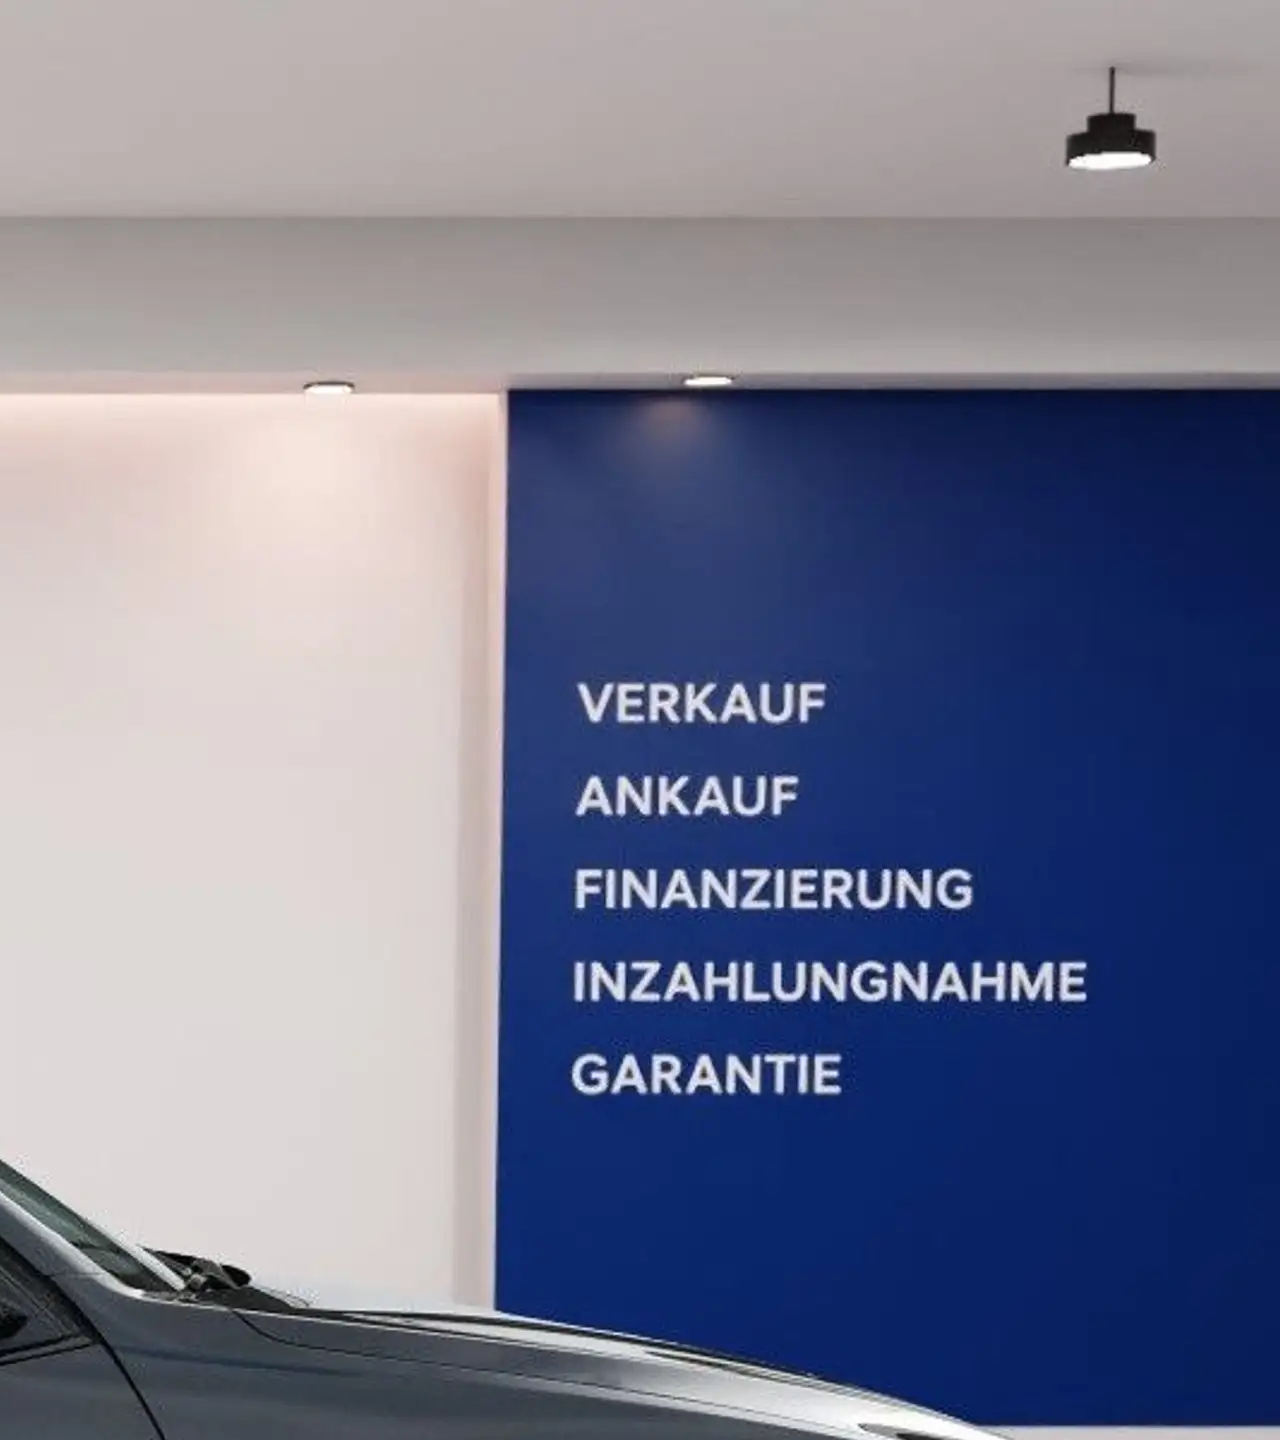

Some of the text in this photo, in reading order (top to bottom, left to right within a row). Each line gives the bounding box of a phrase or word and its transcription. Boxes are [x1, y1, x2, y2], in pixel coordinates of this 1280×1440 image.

[576, 682, 827, 724] VERKAUF
[574, 775, 800, 816] ANKAUF
[573, 868, 975, 910] FINANZIERUNG
[572, 961, 1089, 1003] INZAHLUNGNAHME
[570, 1053, 843, 1095] GARANTIE
